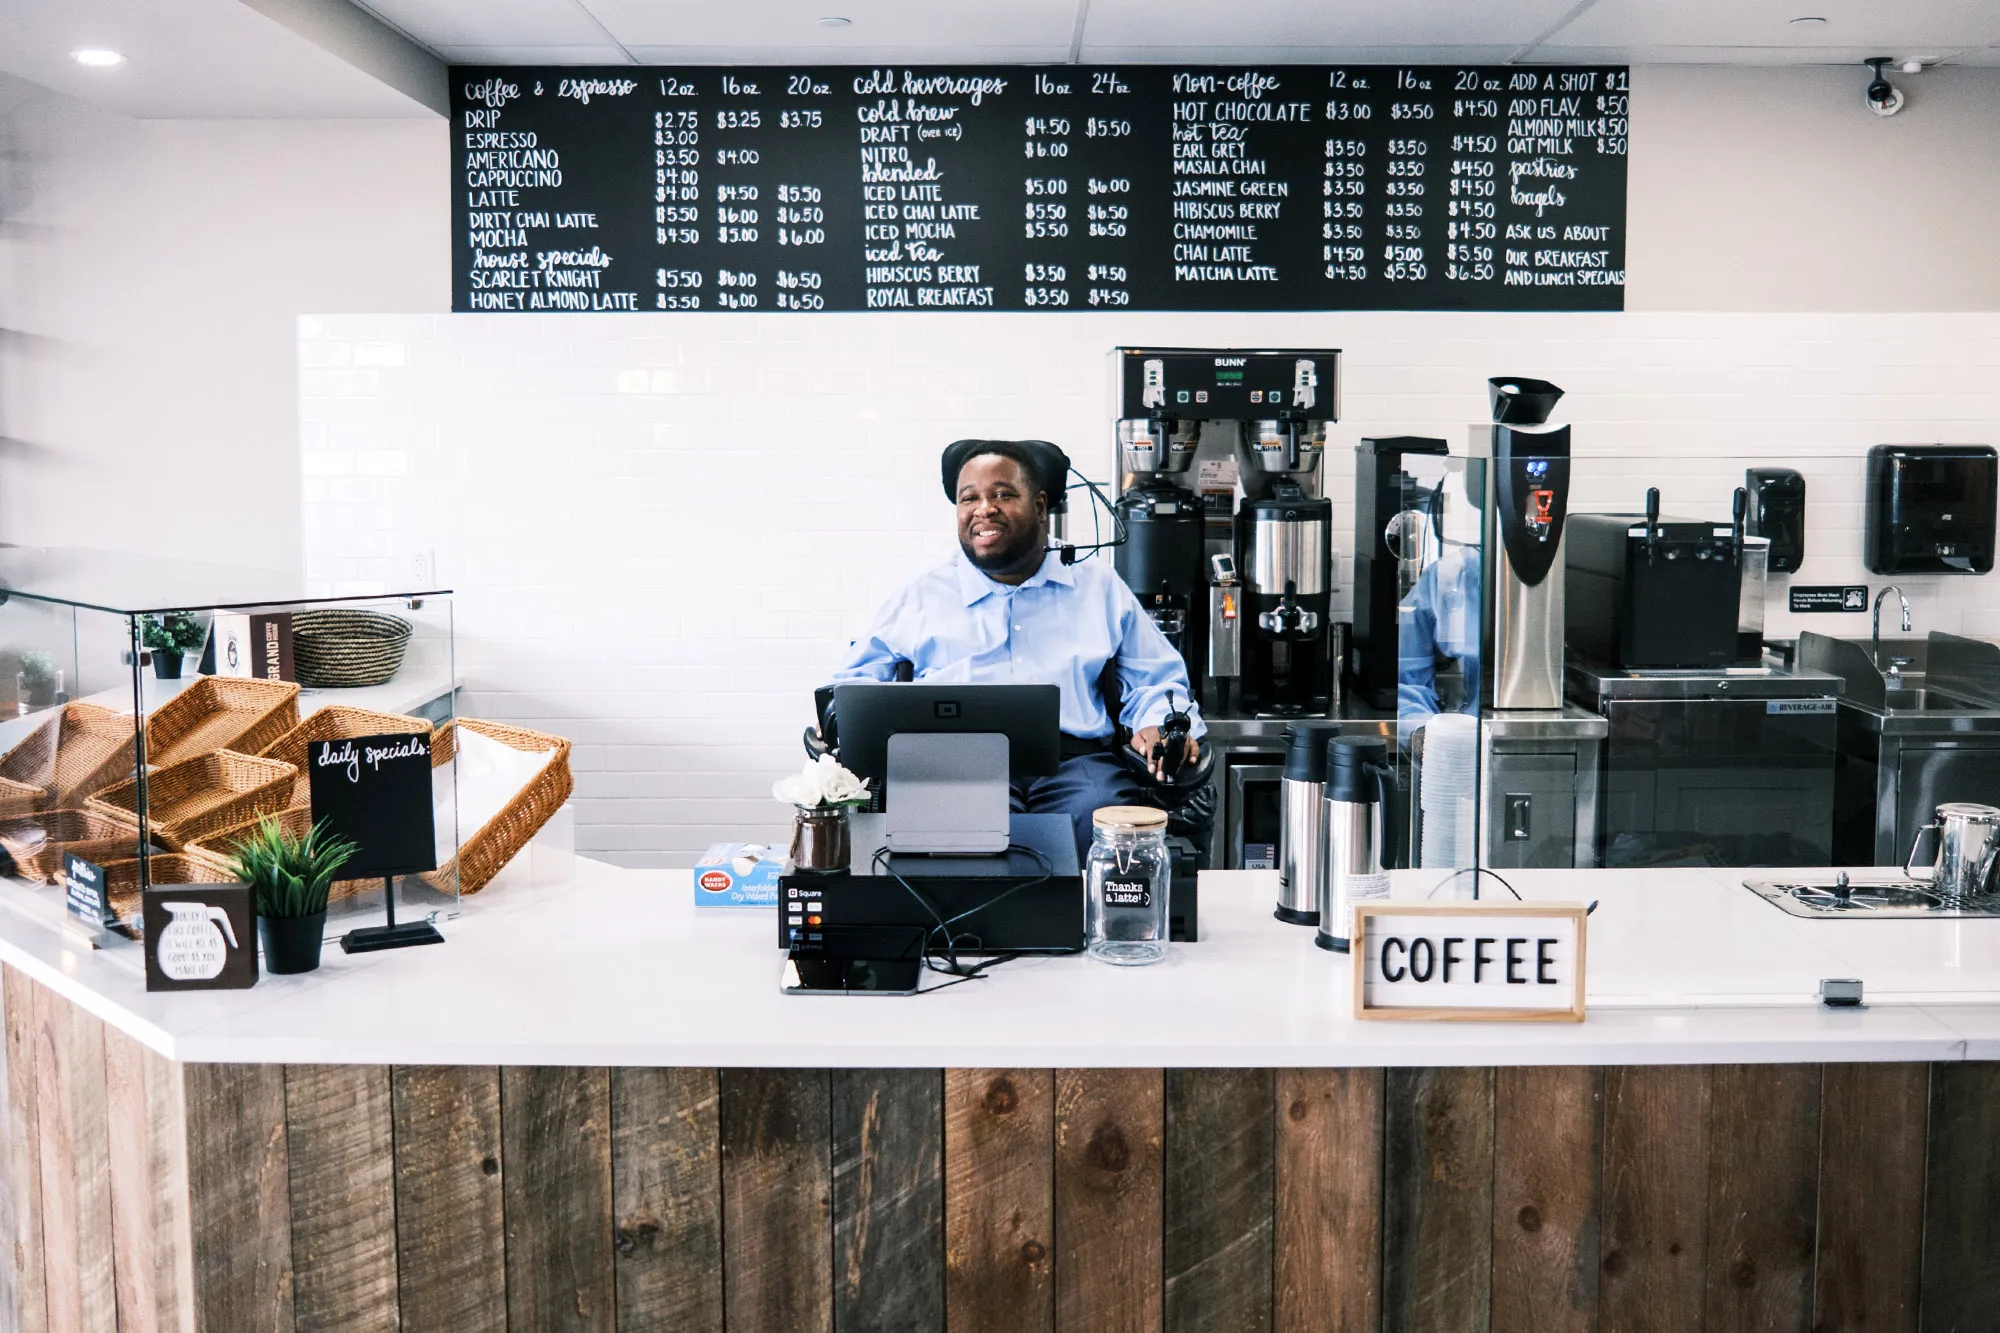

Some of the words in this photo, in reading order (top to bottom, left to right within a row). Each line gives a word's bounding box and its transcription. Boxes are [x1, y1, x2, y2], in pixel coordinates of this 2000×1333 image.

[853, 69, 898, 95] cold
[901, 70, 1008, 107] beverages
[1508, 73, 1538, 91] ADD
[1543, 73, 1554, 91] A
[1559, 72, 1598, 92] SHOT
[1605, 71, 1630, 91] $1
[465, 78, 521, 108] coffee
[533, 81, 544, 96] &
[557, 78, 638, 105] espresso
[857, 98, 903, 124] cold
[905, 98, 960, 122] brew
[1173, 101, 1208, 122] HOT
[1214, 101, 1311, 122] CHOCOLATE
[1325, 100, 1371, 121] $3.00
[1507, 98, 1537, 117] ADD
[1540, 96, 1581, 117] FLAV.
[1596, 95, 1630, 117] $.50
[465, 109, 501, 129] DRIP
[654, 111, 698, 130] $2.75
[717, 110, 761, 130] $3.25
[779, 110, 823, 129] $3.75
[860, 124, 911, 144] DRAFT
[1025, 116, 1071, 137] $4.50
[1085, 117, 1131, 139] $5.50
[1507, 118, 1564, 138] ALMOND
[1566, 118, 1597, 138] MILK
[1597, 116, 1628, 137] $.50
[465, 131, 538, 149] ESPRESSO
[654, 129, 699, 147] $3.00
[1172, 122, 1207, 142] hot
[860, 146, 909, 164] NITRO
[1024, 141, 1068, 159] $6.00
[1173, 143, 1208, 159] EARL
[1211, 141, 1246, 159] GREY
[1507, 137, 1536, 154] OAT
[1537, 137, 1574, 155] MILK
[1596, 137, 1627, 156] $.50
[466, 148, 559, 170] AMERICANO
[655, 147, 700, 167] $3.50
[716, 148, 760, 166] $4.00
[1173, 159, 1230, 175] MASALA
[1232, 159, 1266, 175] CHAI
[467, 168, 563, 188] CAPPUCCINO
[656, 167, 699, 186] $4.00
[860, 157, 945, 183] blended
[1508, 158, 1579, 185] pastries
[468, 190, 520, 208] LATTE
[654, 185, 699, 203] $4.00
[717, 184, 759, 203] $4.50
[863, 184, 897, 202] ICED
[900, 183, 943, 202] LATTE
[1024, 177, 1068, 196] $5.00
[1087, 178, 1130, 195] $6.00
[1172, 180, 1237, 198] JASMINE
[1240, 181, 1288, 197] GREEN
[864, 203, 899, 221] ICED
[902, 204, 936, 221] CHAI
[940, 204, 981, 221] LATTE
[1173, 201, 1235, 220] HIBISCUS
[1239, 201, 1281, 219] BERRY
[1323, 200, 1363, 218] $3.50
[1510, 185, 1567, 218] bagels
[468, 211, 512, 230] DIRTY
[515, 211, 550, 229] CHAI
[555, 212, 599, 229] LATTE
[655, 205, 699, 225] $5.50
[468, 228, 529, 249] MOCHA
[777, 227, 826, 247] $6.00
[864, 224, 900, 241] ICED
[904, 221, 956, 240] MOCHA
[1173, 222, 1258, 240] CHAMOMILE
[1322, 222, 1363, 240] $3.50
[1447, 221, 1497, 240] $4.50
[1505, 223, 1532, 240] ASK
[1536, 225, 1557, 240] US
[1563, 225, 1611, 242] ABOUT
[473, 247, 530, 270] house
[535, 245, 614, 277] specials
[864, 239, 904, 262] iced
[903, 239, 945, 263] tea
[1173, 243, 1208, 262] CHAI
[1212, 246, 1253, 263] LATTE
[1505, 248, 1529, 267] OUR
[1534, 249, 1610, 268] BREAKFAST
[469, 269, 542, 290] SCARLET
[545, 269, 603, 289] KNIGHT
[656, 267, 703, 288] $5.50
[865, 265, 933, 284] HIBISCUS
[936, 264, 980, 284] BERRY
[1174, 265, 1232, 282] MATCHA
[1236, 265, 1279, 281] LATTE
[1444, 262, 1495, 281] $6.50
[1503, 269, 1534, 286] AND
[1534, 271, 1575, 286] LUNCH
[1576, 269, 1626, 287] SPECIALS
[469, 291, 525, 310] HONEY
[529, 290, 590, 311] ALMOND
[591, 292, 639, 311] LATTE
[866, 287, 915, 308] ROYAL
[916, 286, 994, 307] BREAKFAST
[1215, 358, 1244, 366] BUNN
[318, 741, 360, 783] daily
[365, 737, 431, 771] specials:
[799, 890, 822, 898] Square
[1105, 881, 1143, 892] Thanks
[1106, 894, 1112, 902] a
[1114, 892, 1142, 903] latte!
[1381, 937, 1557, 984] COFFEE
